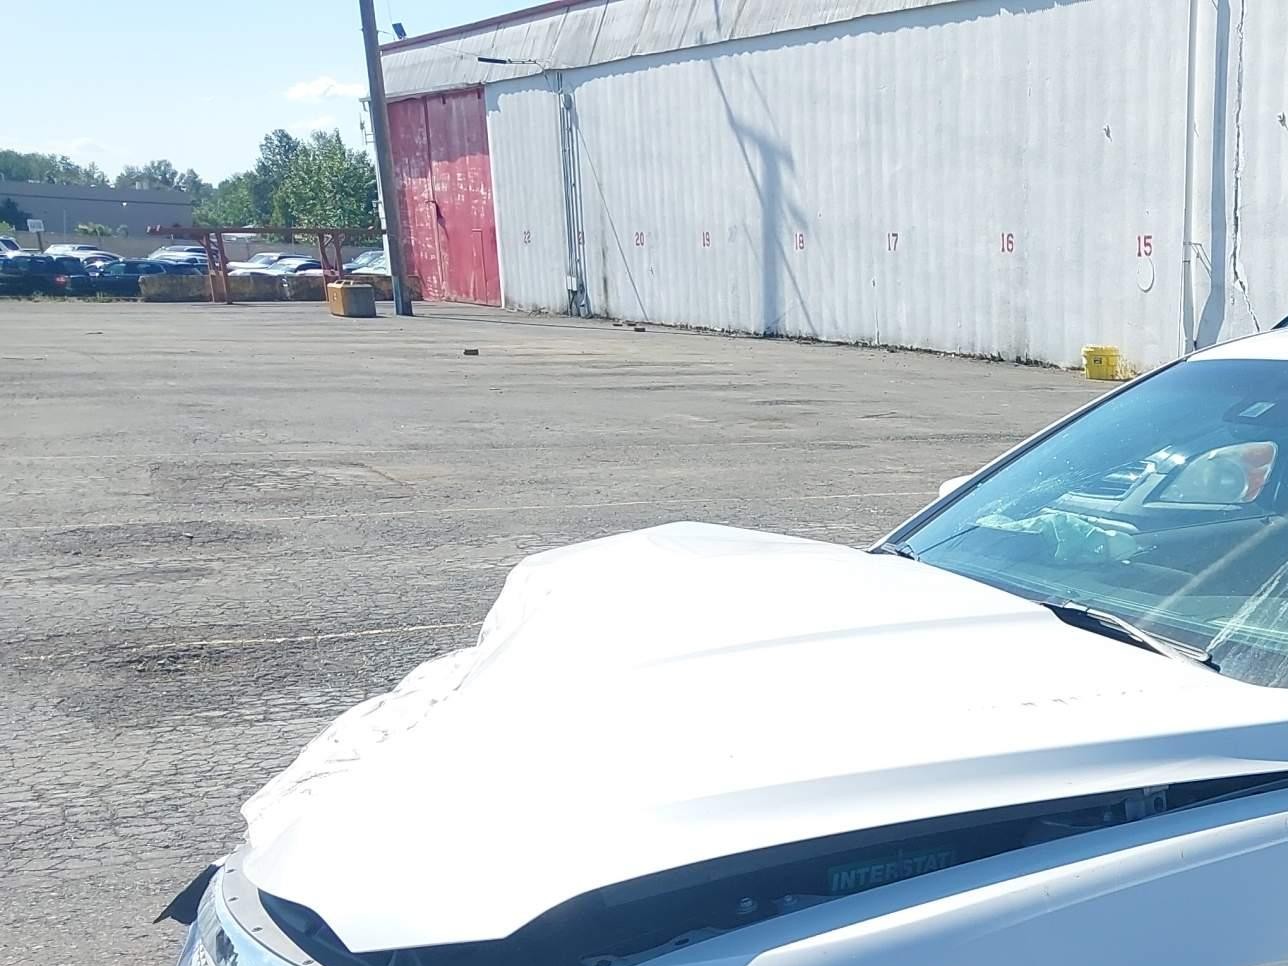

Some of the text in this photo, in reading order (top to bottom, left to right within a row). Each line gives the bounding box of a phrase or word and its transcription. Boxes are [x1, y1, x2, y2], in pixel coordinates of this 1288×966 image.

[635, 231, 645, 247] 20
[702, 231, 710, 247] 19
[795, 233, 805, 250] 18
[887, 232, 898, 251] 17
[1001, 232, 1014, 253] 16
[1137, 235, 1152, 257] 15
